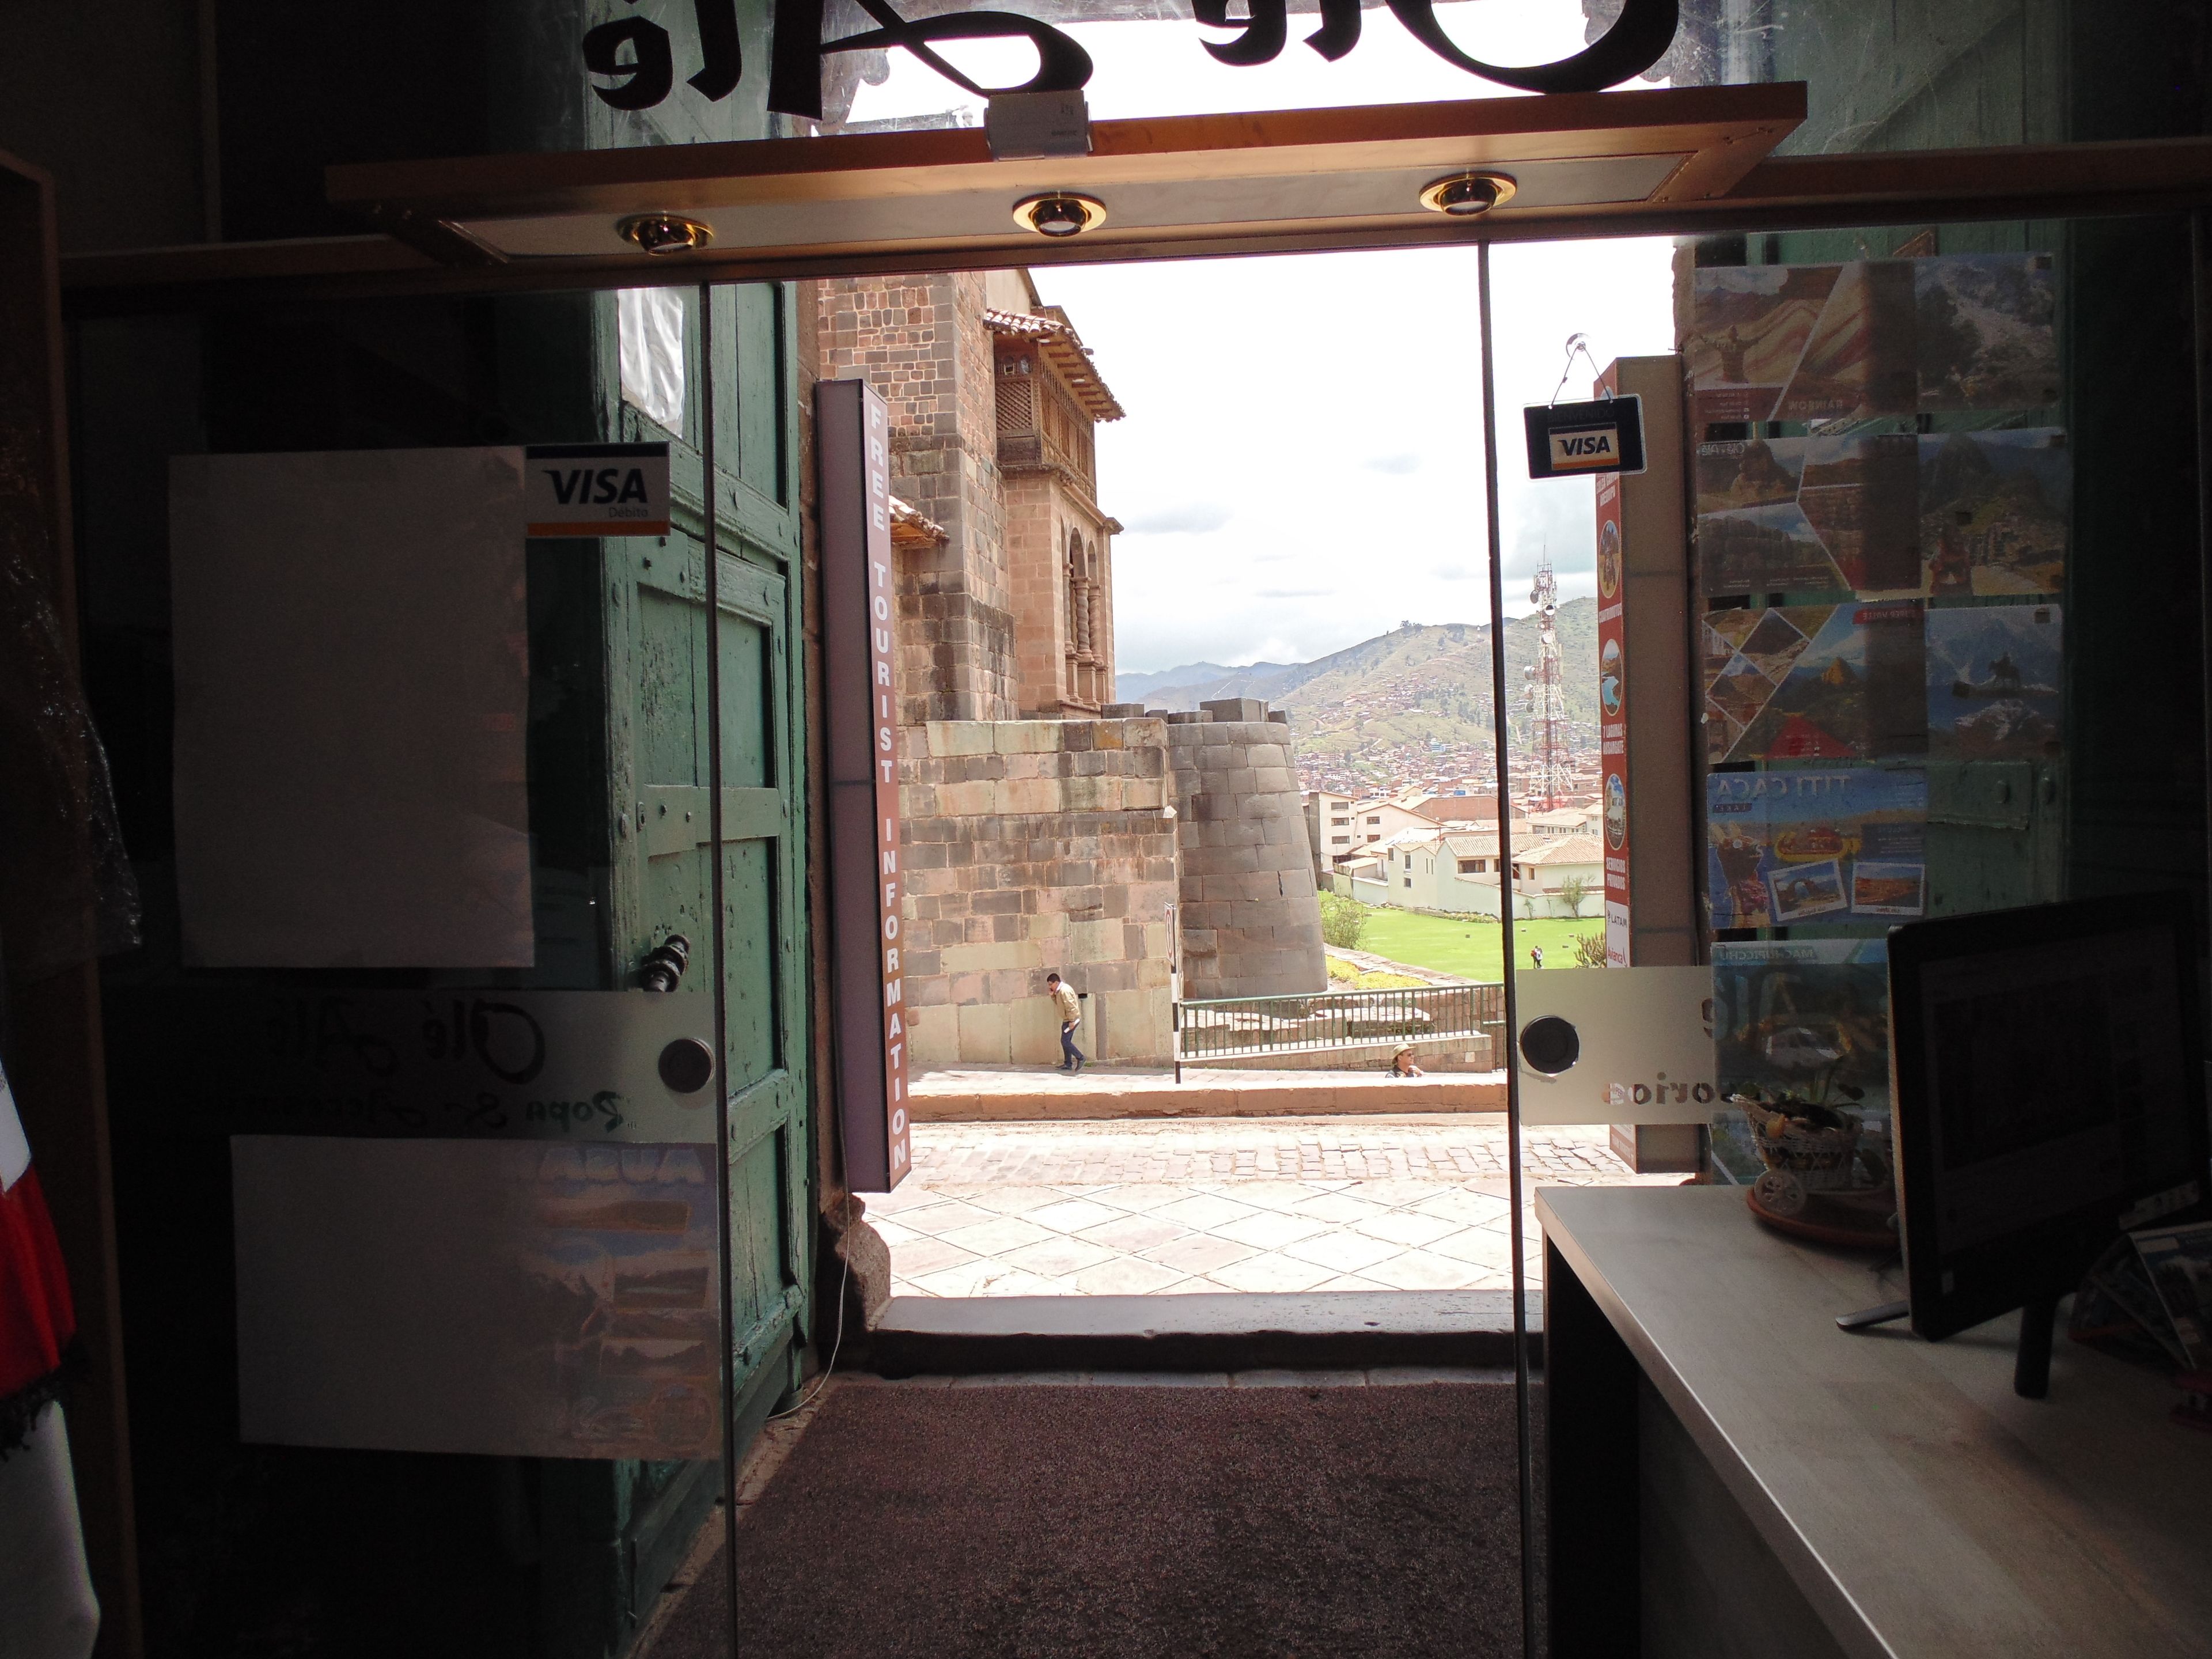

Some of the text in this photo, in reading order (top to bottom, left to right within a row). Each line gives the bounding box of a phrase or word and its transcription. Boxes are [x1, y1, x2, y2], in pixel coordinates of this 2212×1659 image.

[1547, 408, 1615, 422] BIENVENIDO
[1557, 436, 1611, 456] VISA
[870, 403, 885, 531] FREE
[543, 468, 648, 505] VISA
[873, 561, 892, 784] TOURIST
[1606, 723, 1623, 738] LAGUNAS
[1606, 857, 1626, 873] SERVICIOS
[1607, 873, 1626, 891] PRIVADOS
[1612, 914, 1628, 929] LATAM
[1607, 946, 1624, 965] Avianca
[884, 817, 906, 1171] INFORMATION
